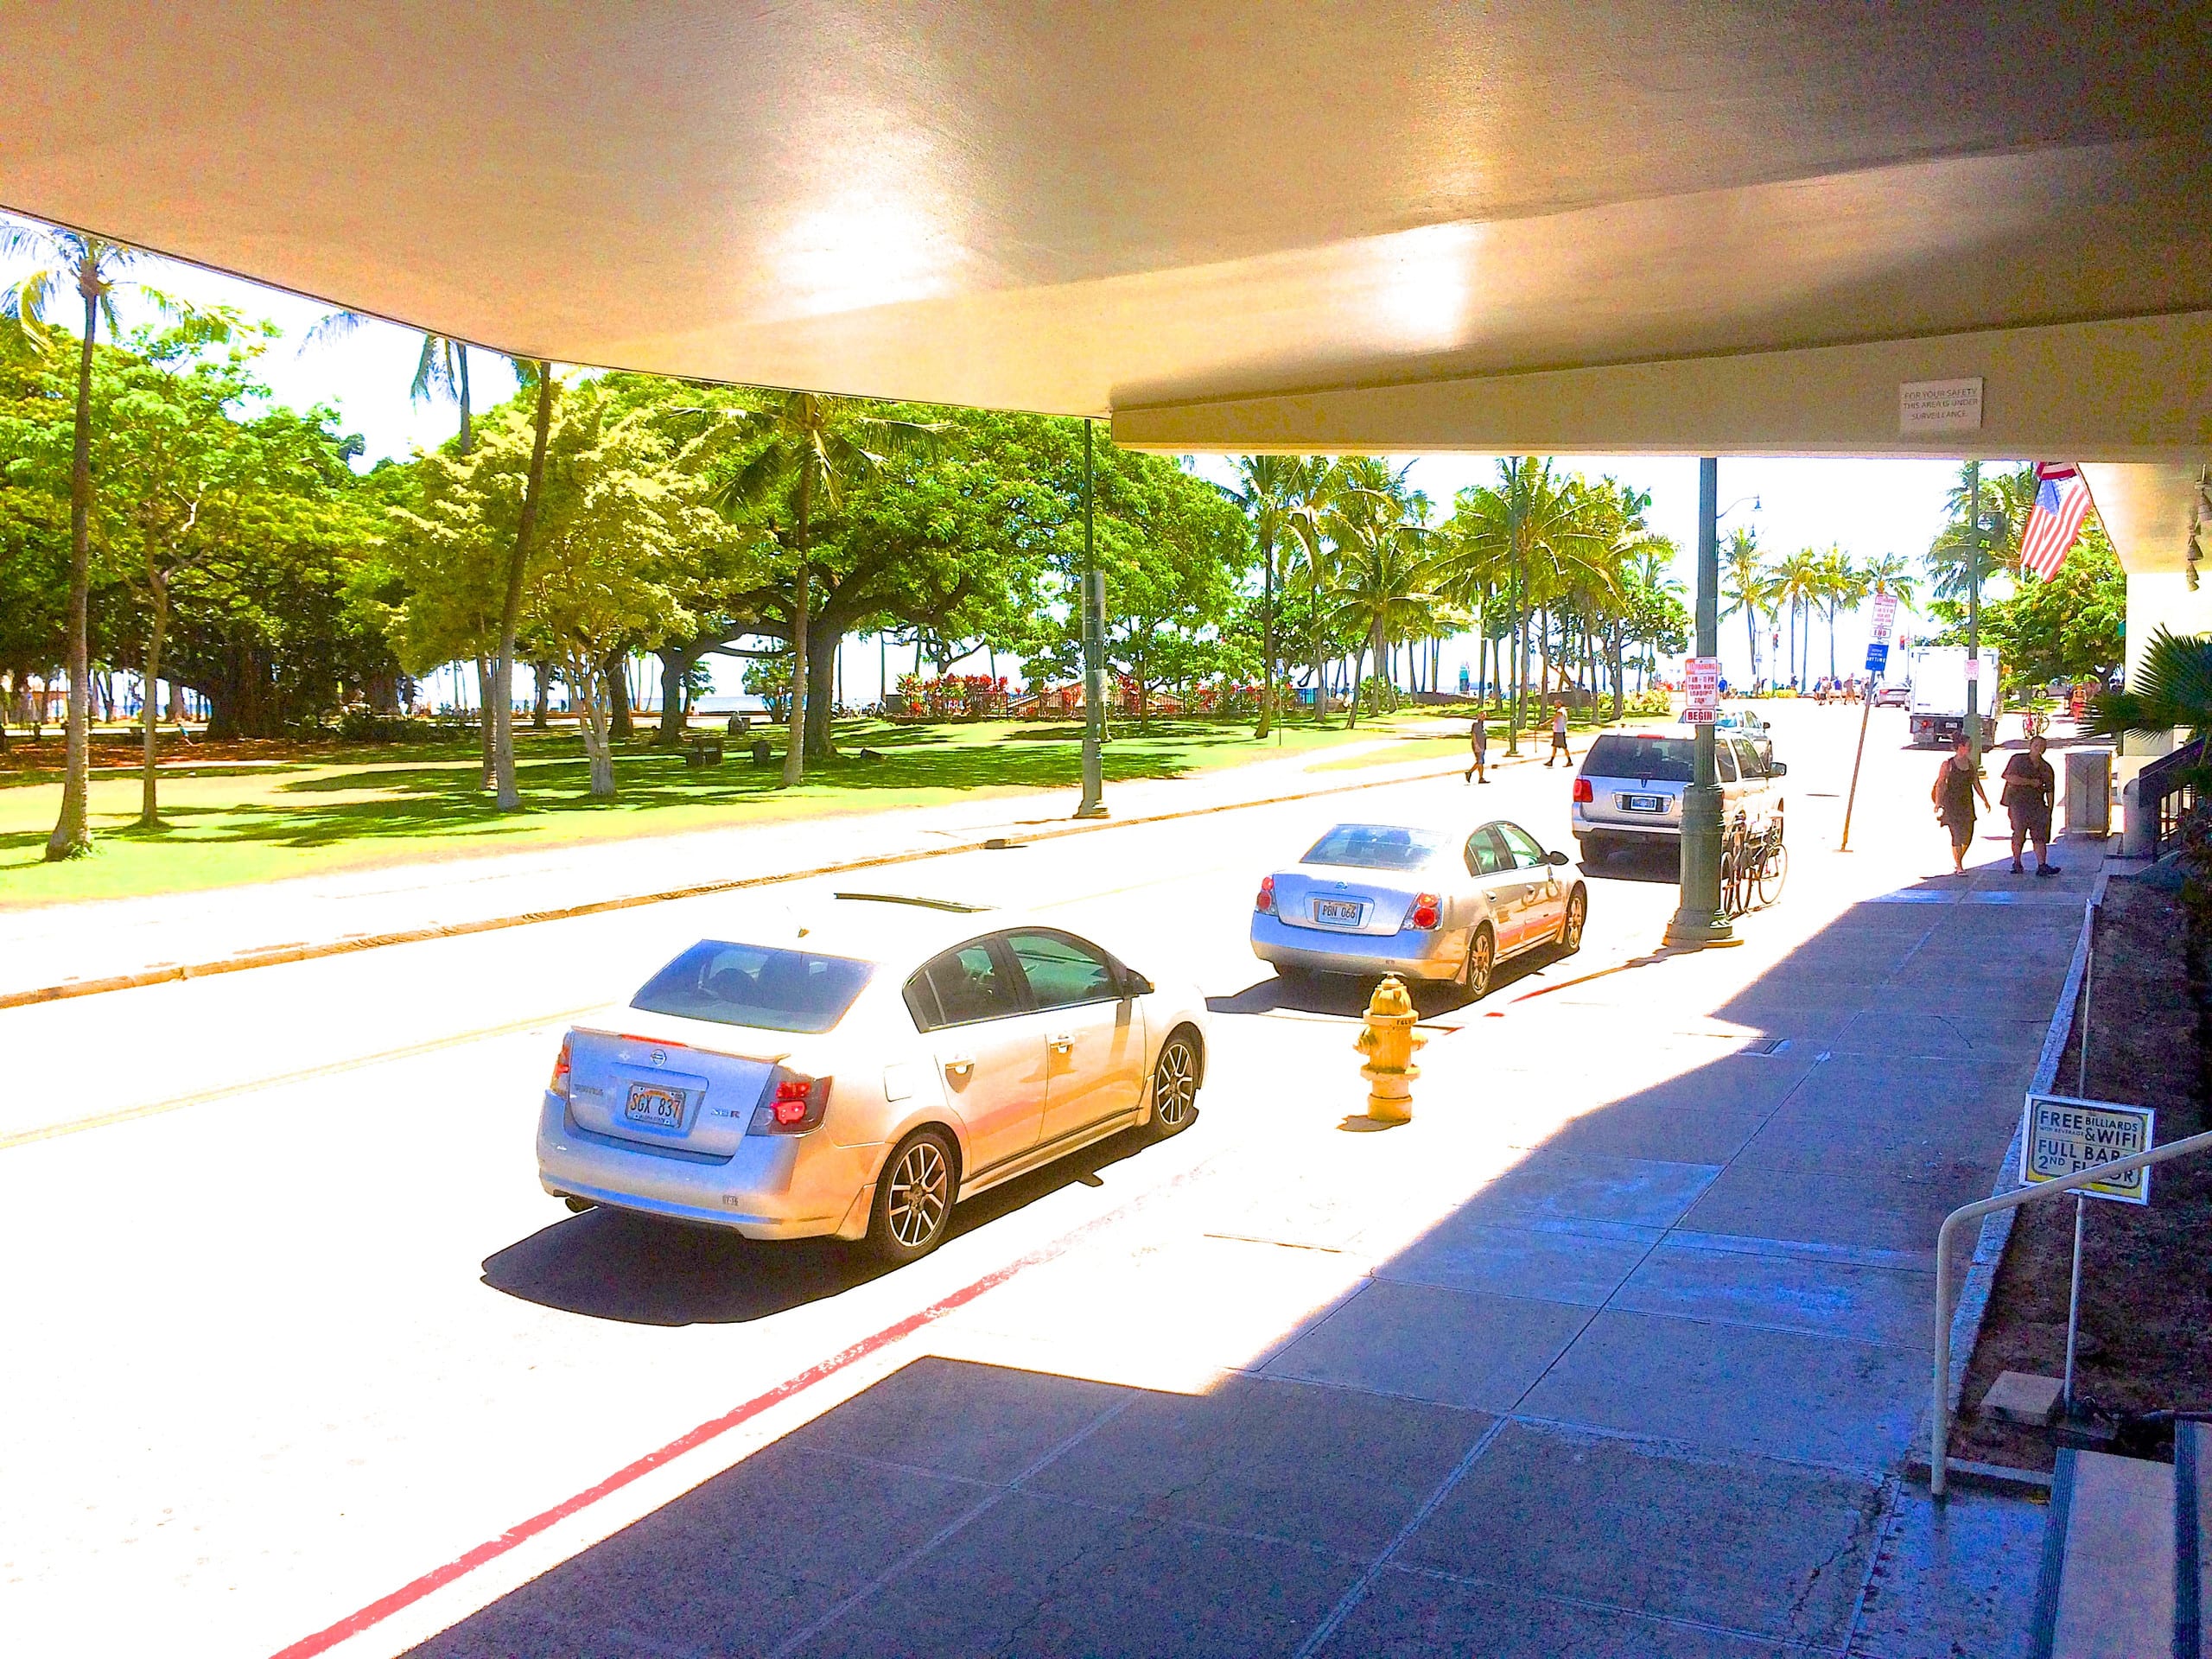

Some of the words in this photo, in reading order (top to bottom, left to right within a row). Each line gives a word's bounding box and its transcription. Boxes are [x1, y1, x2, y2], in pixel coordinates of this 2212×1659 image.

[1923, 390, 1945, 398] YOUR
[1947, 388, 1978, 397] SAFETY
[1921, 400, 1942, 409] AREA
[1910, 410, 1967, 420] SURVEILLANCE
[1688, 711, 1713, 721] BEGIN
[1322, 905, 1338, 917] PBN
[1340, 906, 1356, 918] 066
[630, 1093, 652, 1114] SGX
[658, 1097, 681, 1118] 837
[2040, 1110, 2083, 1130] FREE
[2085, 1116, 2139, 1132] BILLIARDS
[2038, 1139, 2077, 1159] FULL
[2084, 1146, 2120, 1163] BAR
[2038, 1155, 2066, 1170] 2ND
[2072, 1160, 2133, 1183] FLR
